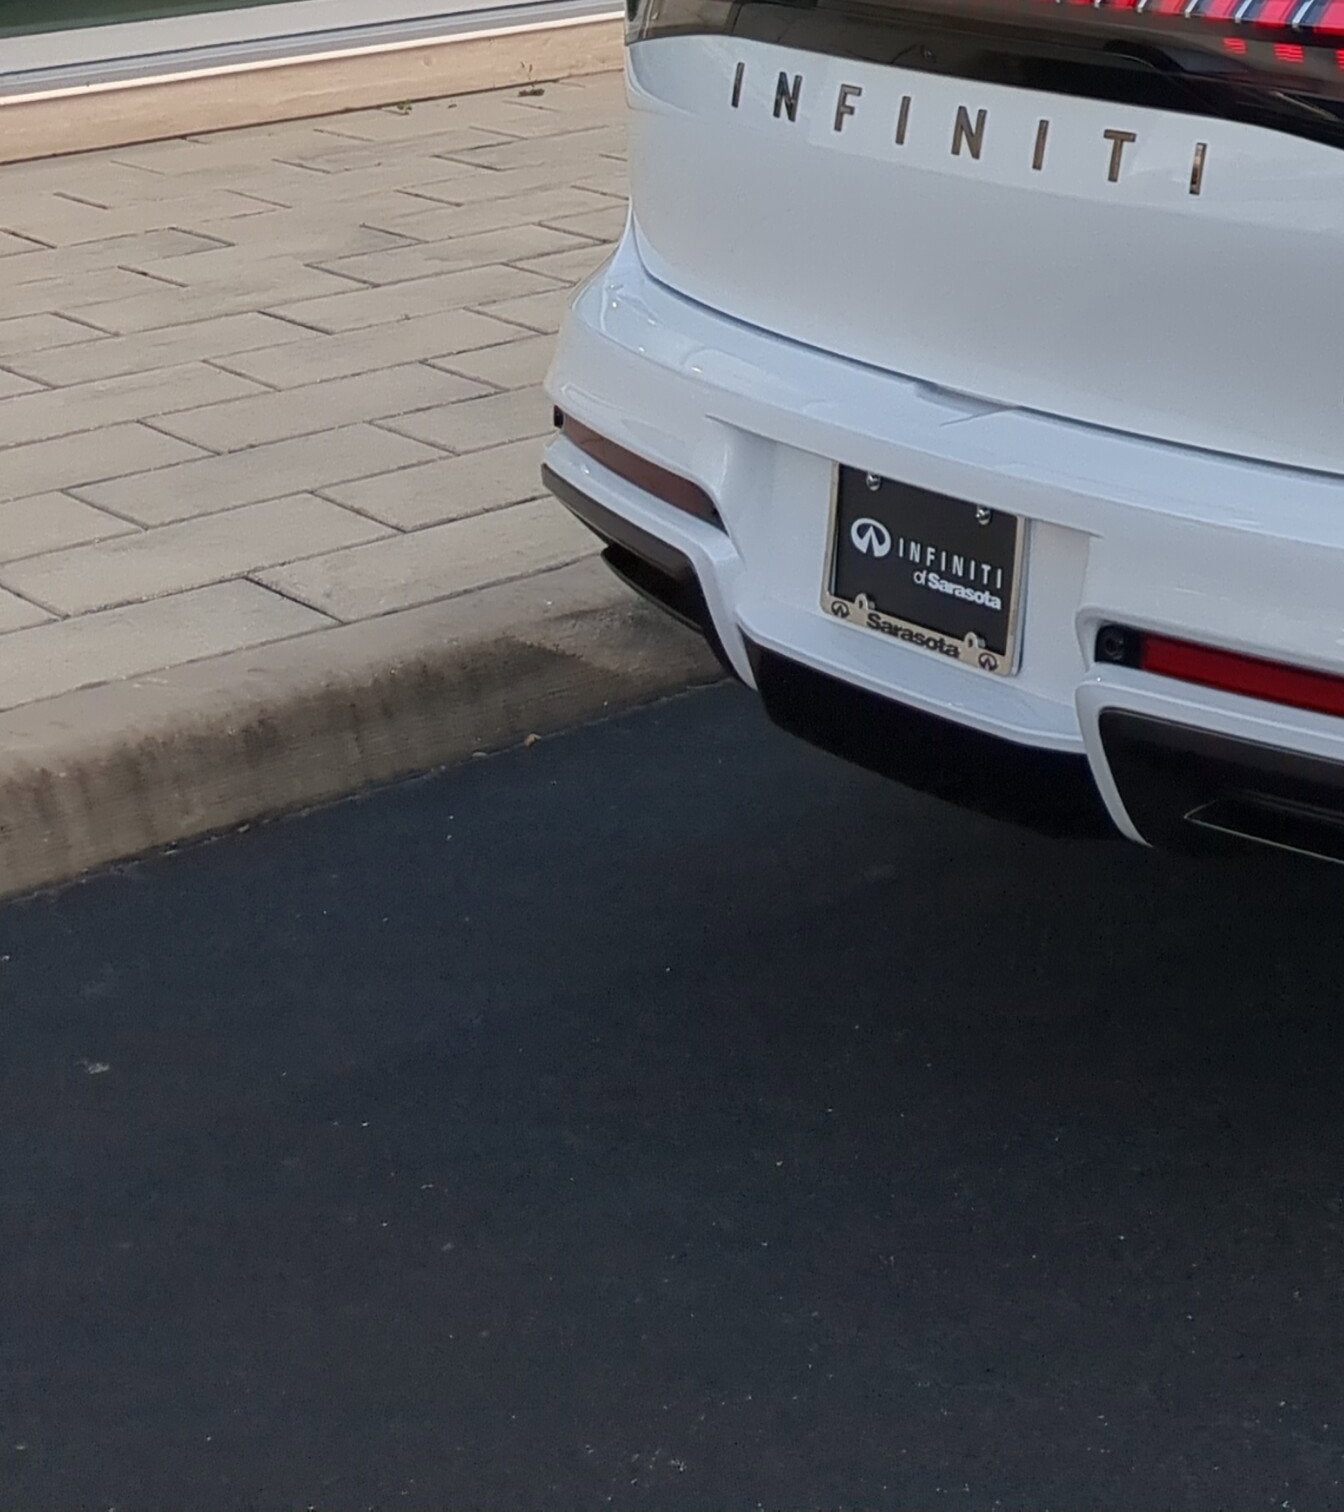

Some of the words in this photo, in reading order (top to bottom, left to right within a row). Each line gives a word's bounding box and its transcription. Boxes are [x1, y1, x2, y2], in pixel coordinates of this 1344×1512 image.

[731, 62, 1207, 195] INFINITI
[899, 538, 1002, 589] INFINITI
[913, 570, 926, 586] of
[928, 572, 1002, 610] Sarasota
[866, 612, 959, 658] Sarasota
